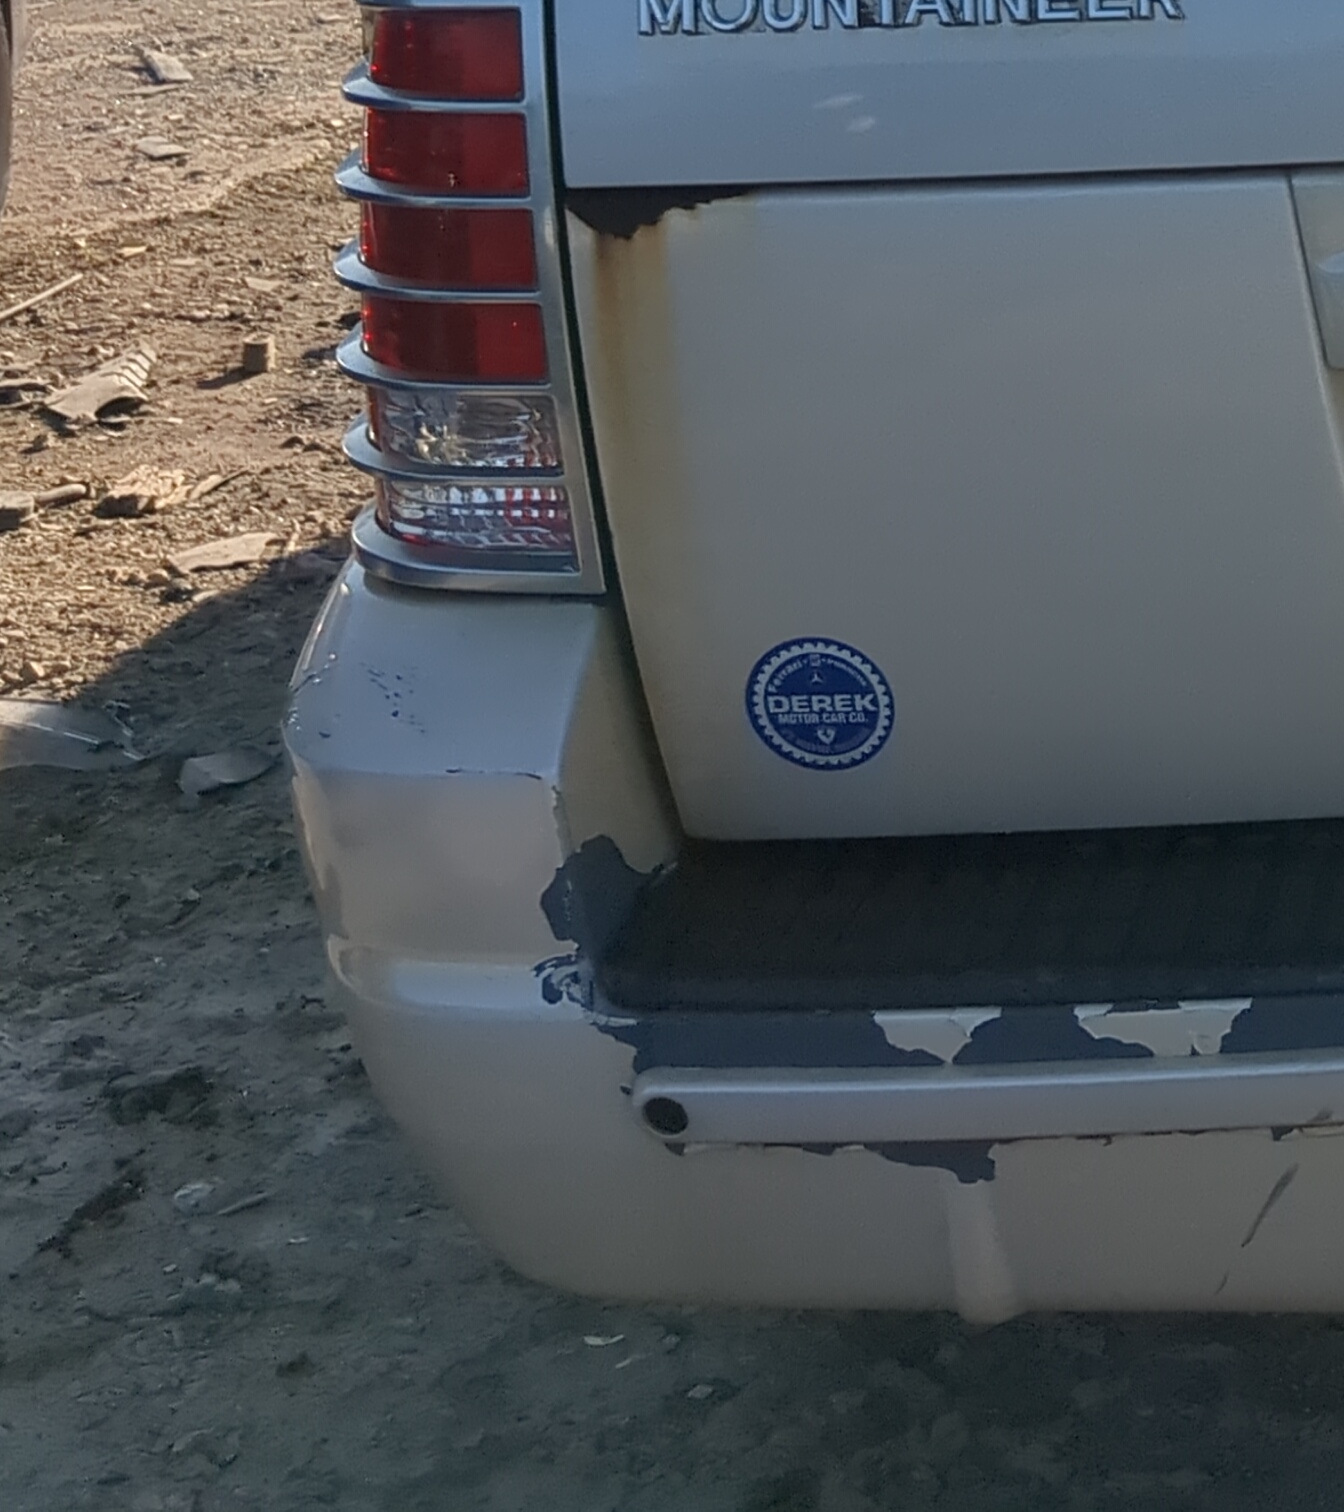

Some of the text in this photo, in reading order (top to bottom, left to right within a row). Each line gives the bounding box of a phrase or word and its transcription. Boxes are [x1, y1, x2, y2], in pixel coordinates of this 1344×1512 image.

[767, 693, 878, 713] DEREK
[778, 712, 820, 724] MOTOR
[822, 712, 847, 724] CAR
